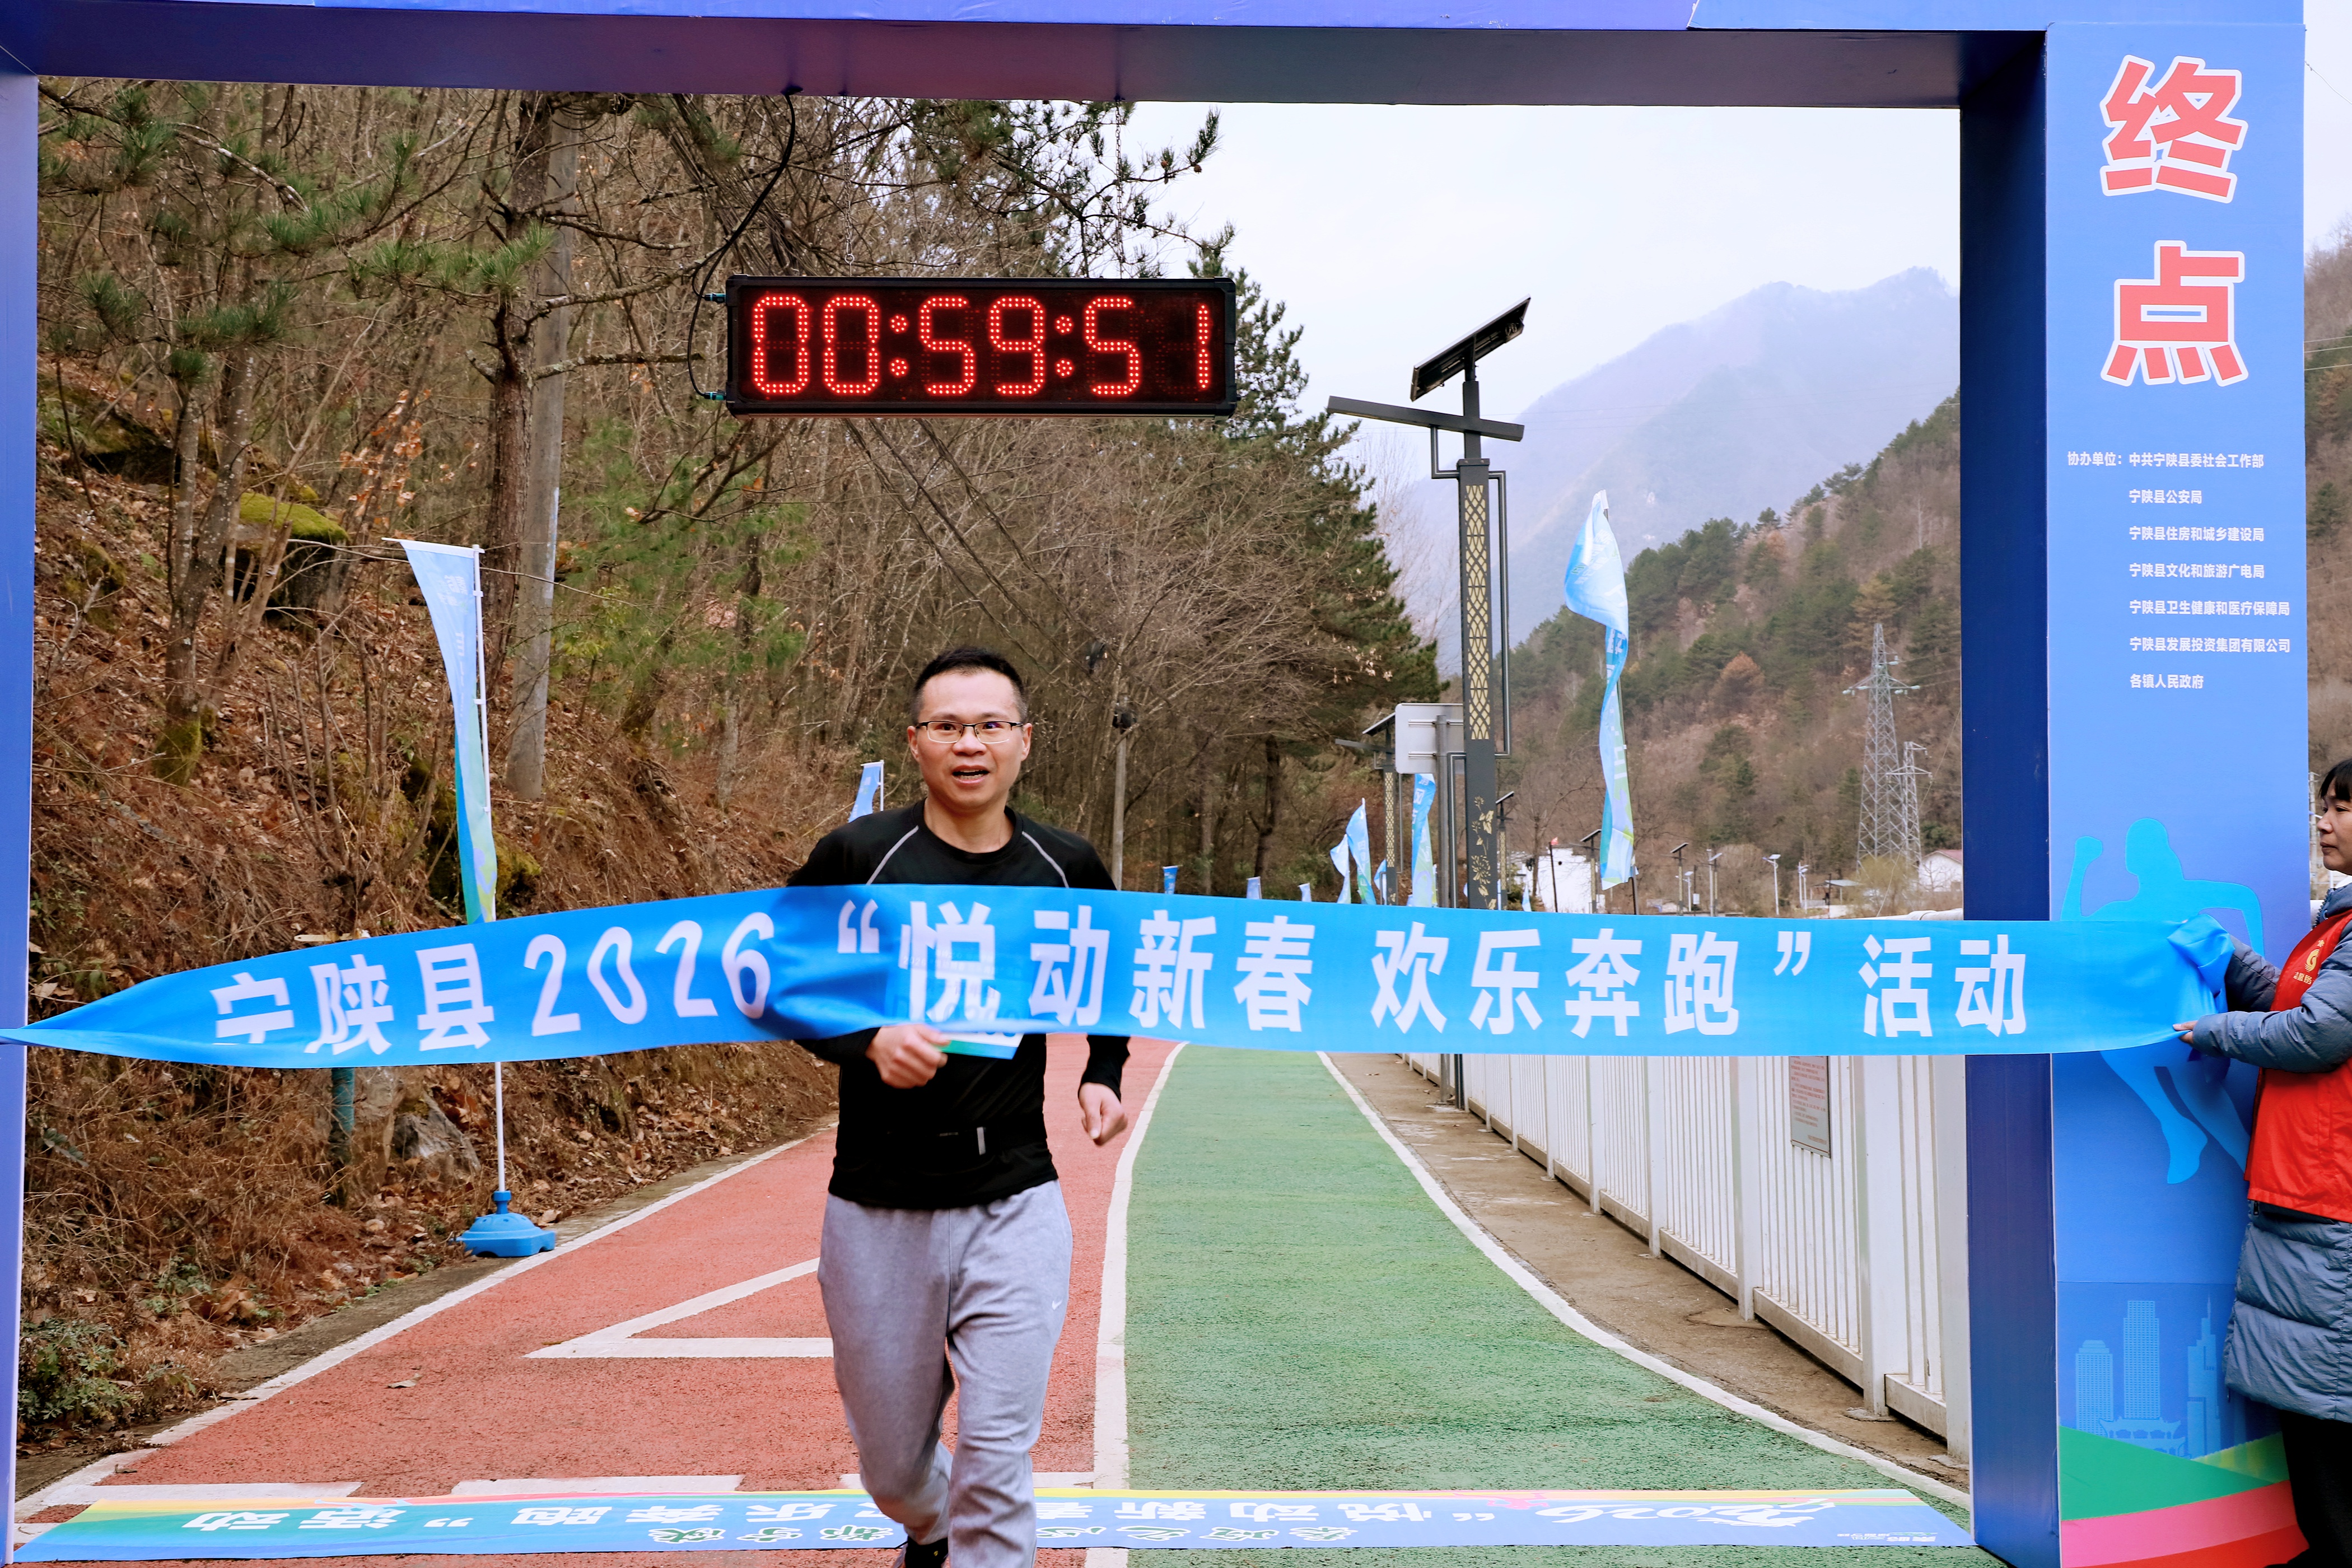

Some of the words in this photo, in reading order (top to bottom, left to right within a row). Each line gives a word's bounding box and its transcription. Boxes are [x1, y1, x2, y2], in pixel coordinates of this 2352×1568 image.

[2101, 55, 2248, 386] 终点
[752, 295, 1210, 396] 00:59:51
[2130, 452, 2264, 468] 中共宁陕县委社会工作部
[2129, 489, 2202, 504] 宁陕县公安局
[2130, 526, 2264, 542] 宁陕县住房和城乡建设局
[2130, 563, 2265, 578] 宁陕县文化和旅游广电局
[2130, 600, 2290, 615] 宁陕县卫生健康和医疗保障局
[2130, 637, 2290, 652] 宁陕县发展投资集团有限公司
[2130, 674, 2204, 689] 各镇人民政府
[183, 1502, 889, 1532] 乐奔跑”活动
